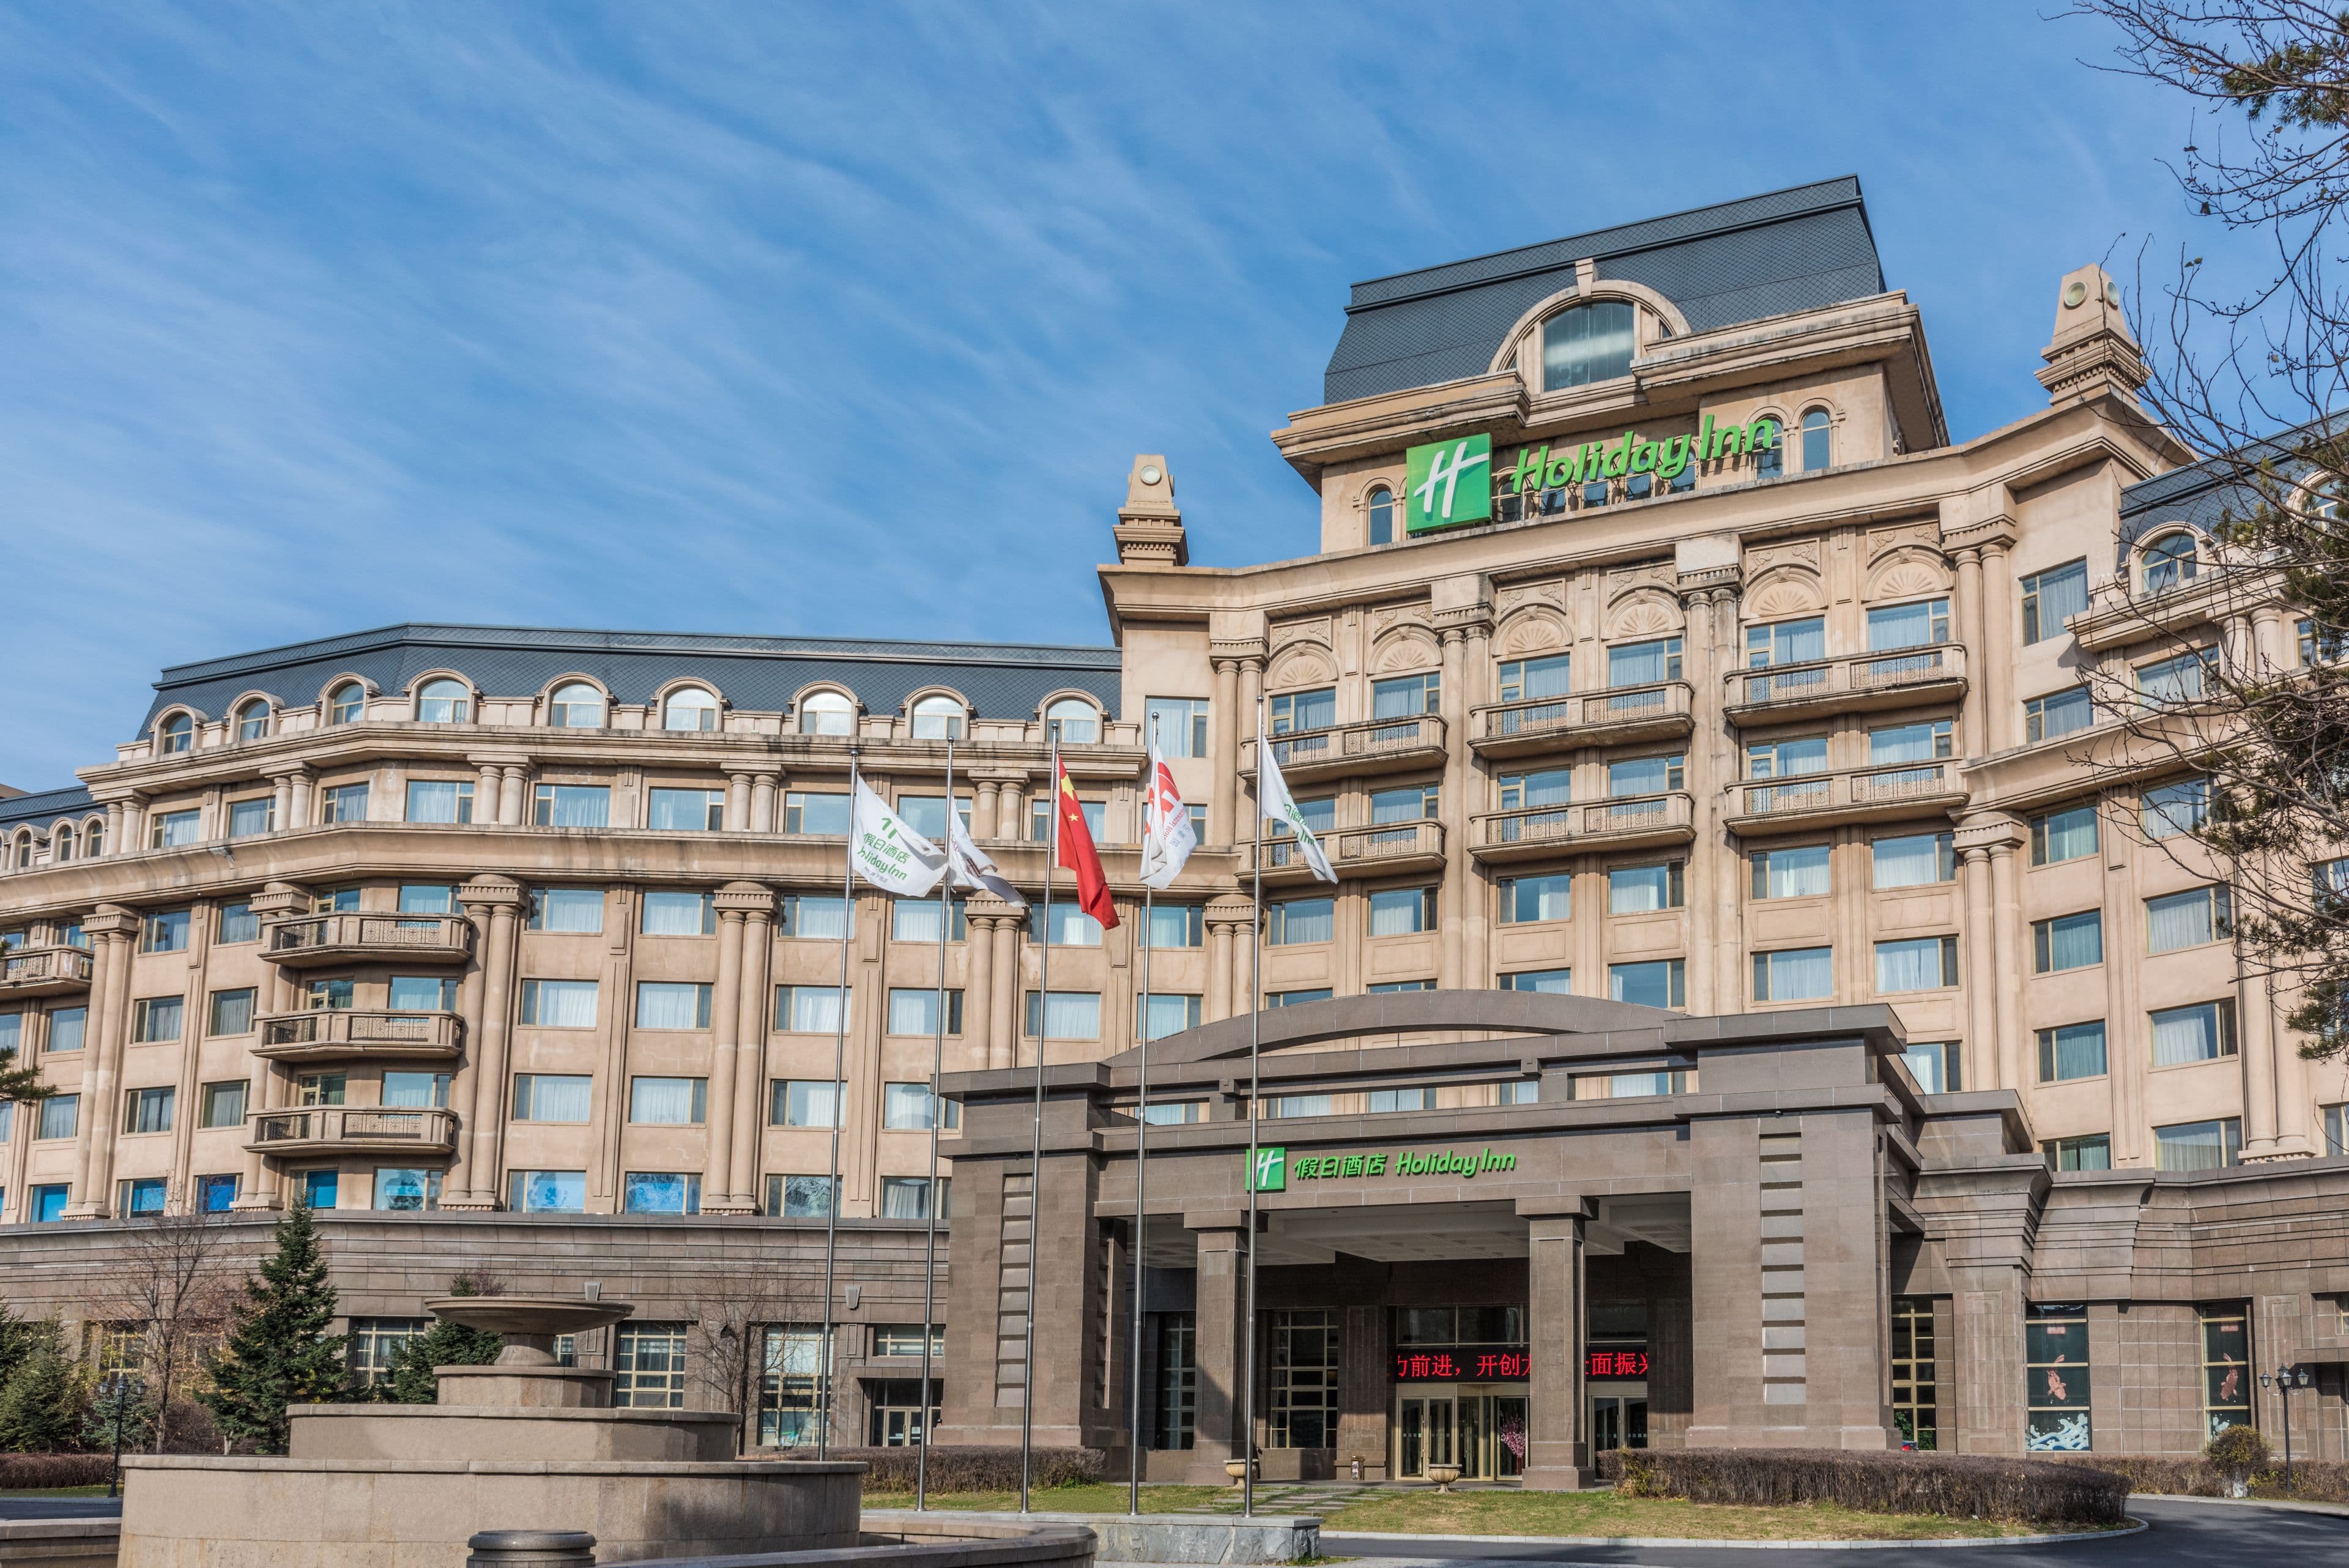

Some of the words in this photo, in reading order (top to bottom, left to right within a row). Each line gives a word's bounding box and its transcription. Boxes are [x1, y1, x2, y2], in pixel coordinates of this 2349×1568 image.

[1510, 430, 1692, 494] Holiday
[1699, 414, 1775, 460] Inn
[863, 833, 910, 864] 假日酒店
[888, 863, 907, 880] Inn
[1293, 1153, 1387, 1178] 假日酒店
[1395, 1150, 1479, 1178] Holiday
[1480, 1147, 1516, 1171] Inn
